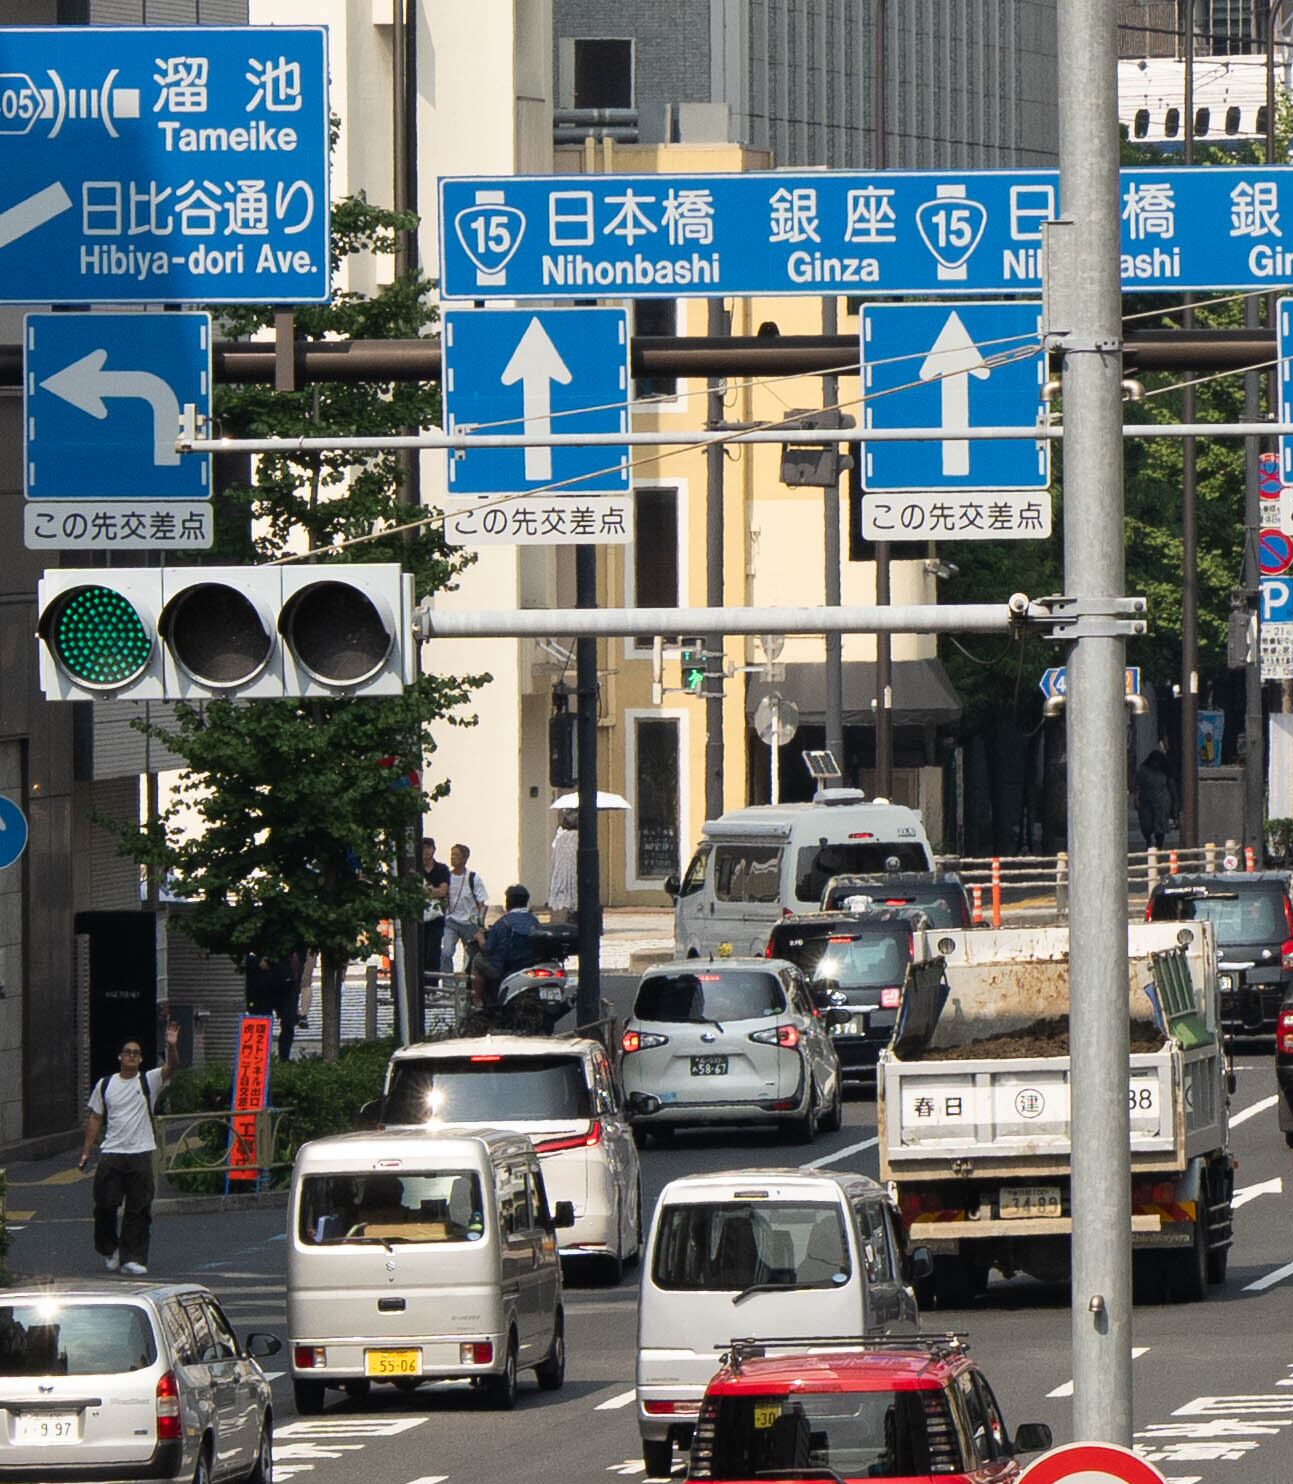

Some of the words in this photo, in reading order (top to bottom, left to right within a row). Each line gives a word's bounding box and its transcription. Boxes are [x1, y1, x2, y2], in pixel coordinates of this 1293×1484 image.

[153, 56, 302, 113] 溜池
[0, 88, 34, 119] 05
[158, 121, 297, 152] Tameike
[82, 179, 315, 237] 日比谷通り
[549, 190, 714, 246] 日本橋
[769, 186, 896, 243] 銀座
[1009, 183, 1176, 241] 日橋
[470, 216, 511, 252] 15
[931, 209, 973, 248] 15
[80, 243, 245, 280] Hibiya-dori
[256, 244, 318, 274] Ave.
[543, 253, 720, 285] Nihonbashi
[787, 251, 880, 283] Ginza
[1003, 248, 1181, 280] Niashi
[34, 511, 206, 541] この先交差点
[454, 506, 626, 537] この先交差点
[872, 502, 1043, 531] この先交差点
[237, 1023, 256, 1111] 虎ノ門二丁目交差
[914, 1097, 963, 1117] 春日
[379, 1359, 417, 1373] 55-06
